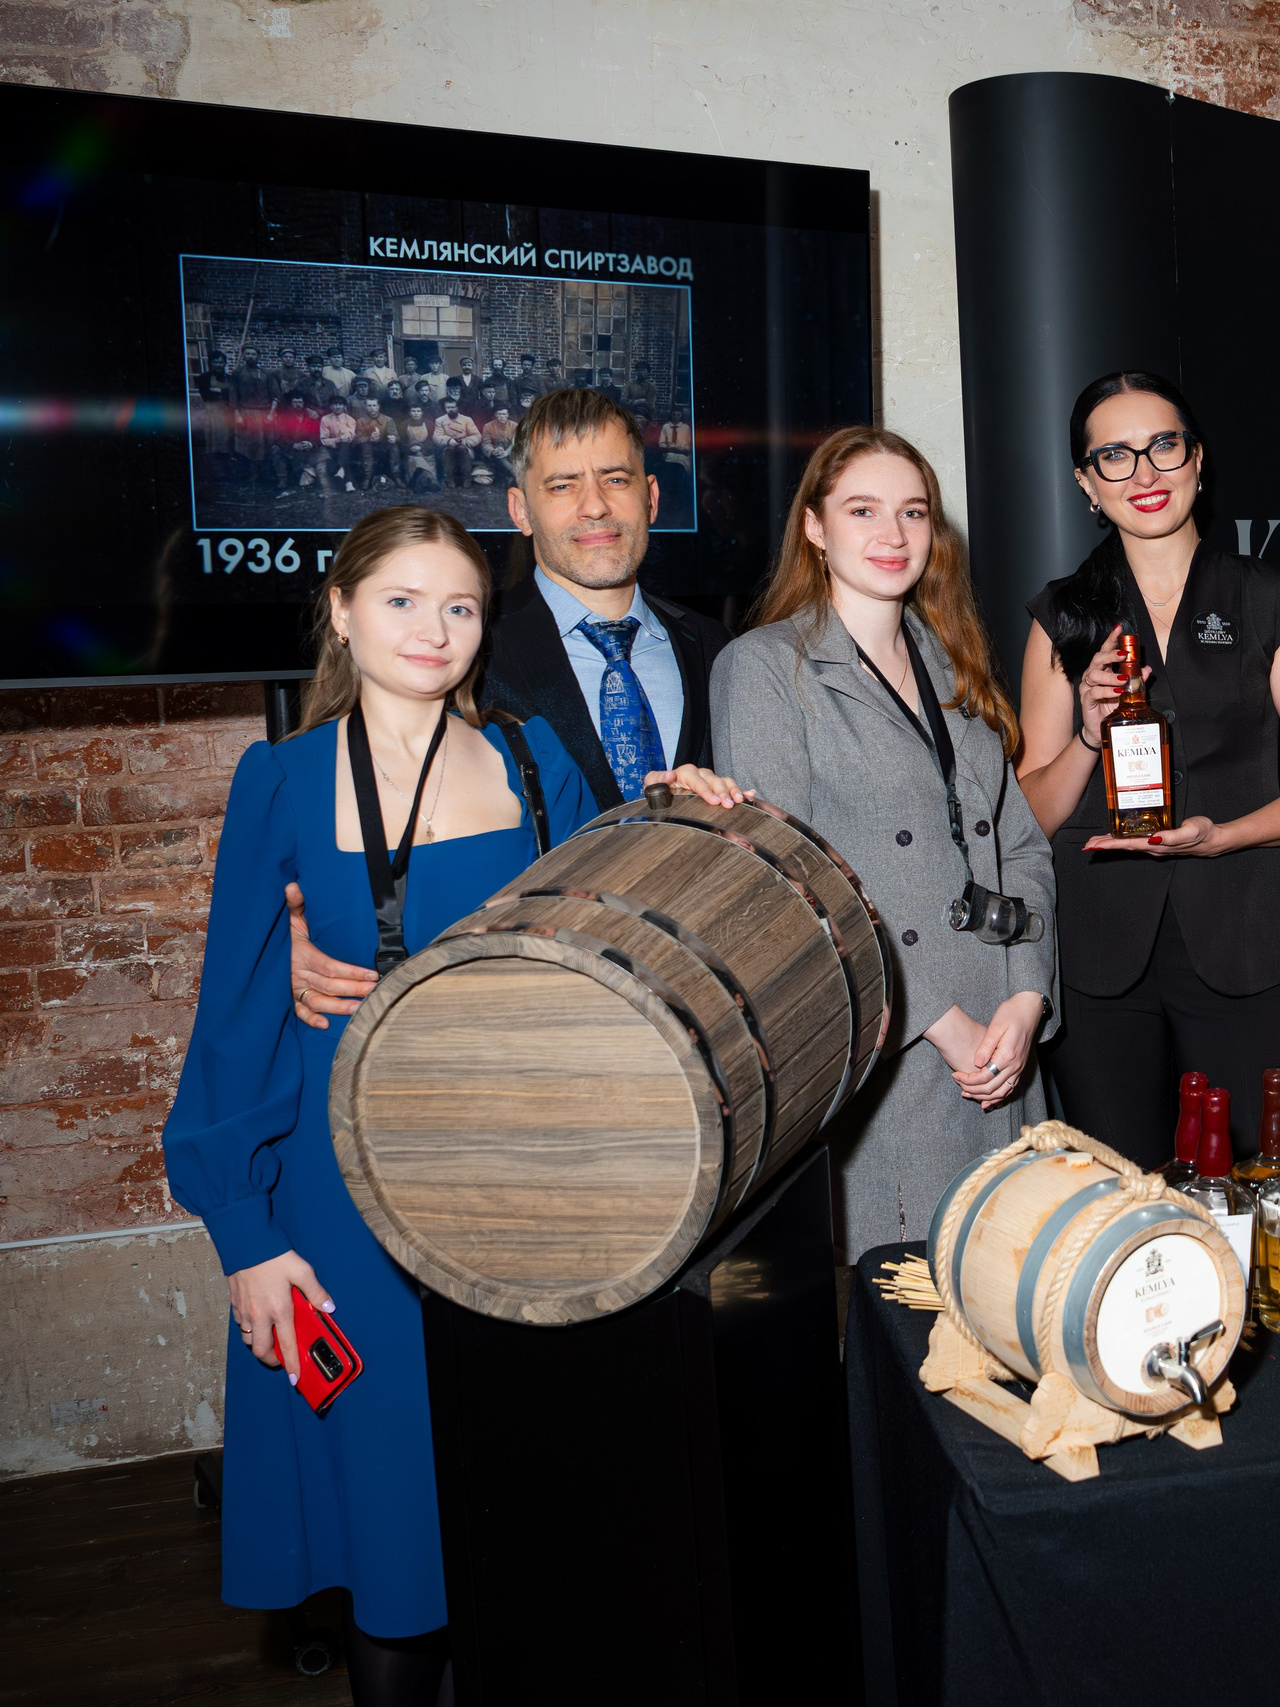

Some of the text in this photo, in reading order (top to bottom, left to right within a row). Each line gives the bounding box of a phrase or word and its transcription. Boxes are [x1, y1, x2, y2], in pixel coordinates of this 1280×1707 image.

[369, 236, 694, 281] КЕМЛЯНСКИЙ СПИРТЗАВОД
[196, 537, 301, 575] 1936
[1197, 632, 1234, 642] KEMLYA
[1117, 747, 1157, 758] KEMLYA
[1135, 1277, 1176, 1298] KEMLYA
